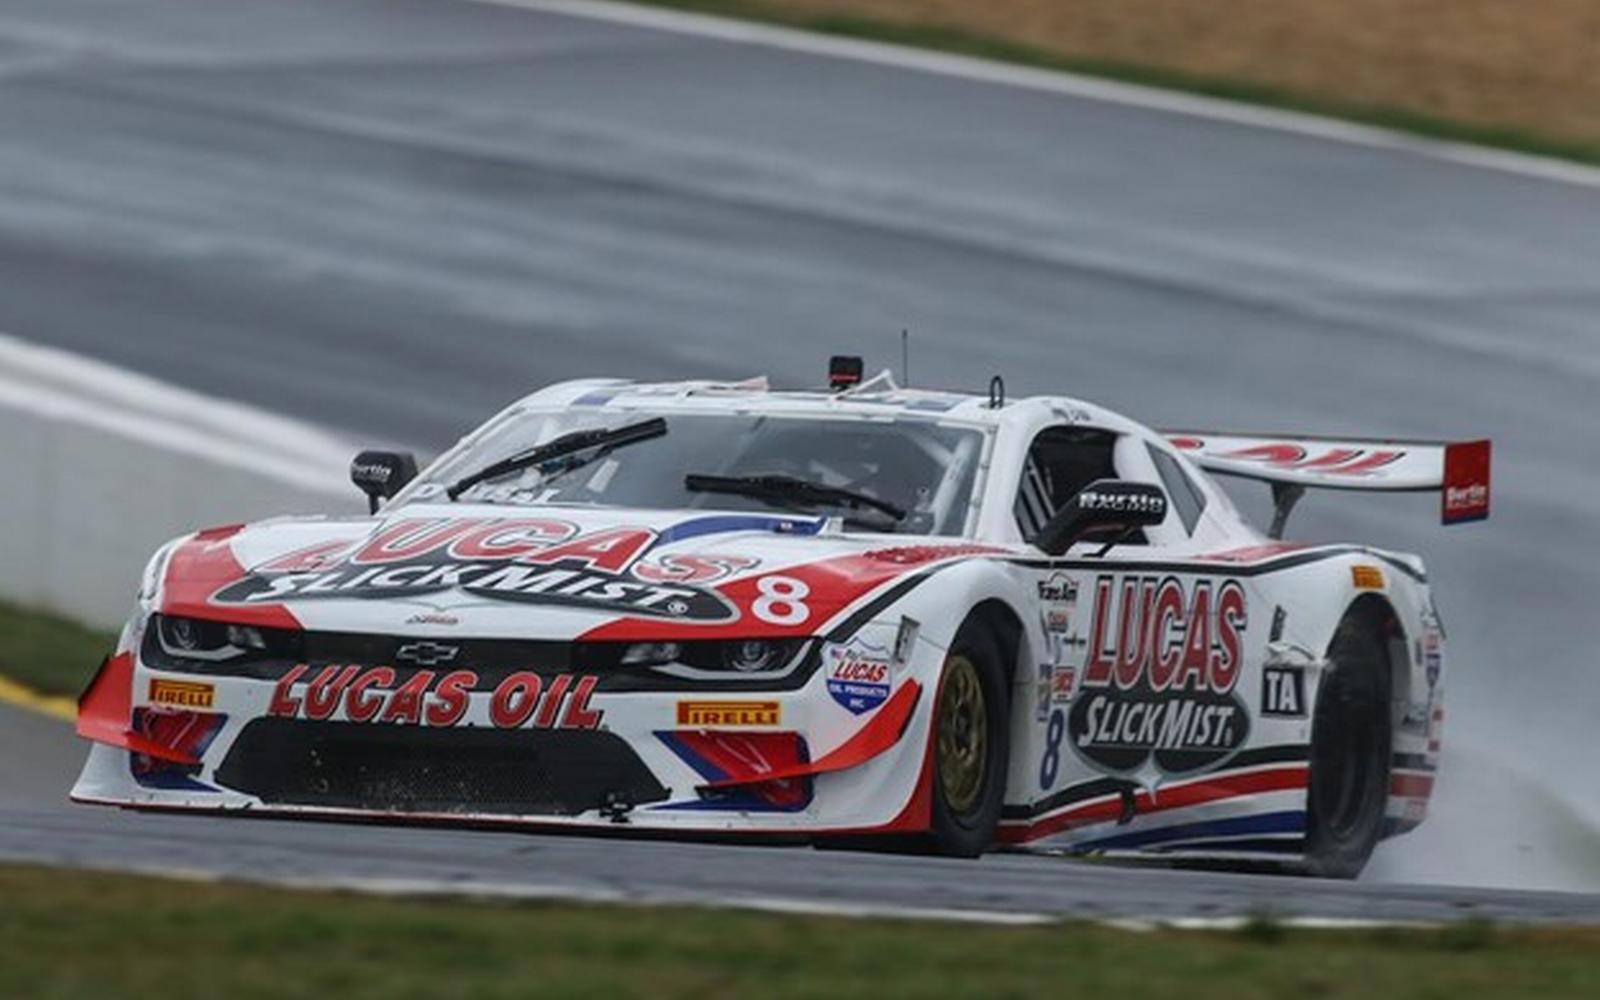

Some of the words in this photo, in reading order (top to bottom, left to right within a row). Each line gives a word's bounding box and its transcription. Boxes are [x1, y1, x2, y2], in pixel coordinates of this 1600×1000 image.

[254, 517, 764, 585] LUCAS
[752, 576, 810, 625] 8
[1080, 574, 1247, 694] LUCAS
[149, 678, 214, 706] PIRELLI
[833, 660, 888, 682] LUCAS
[1265, 670, 1299, 712] TA
[266, 663, 480, 727] LUCAS
[490, 670, 604, 729] OIL
[677, 701, 779, 725] PIRELLI
[1040, 708, 1064, 791] 8
